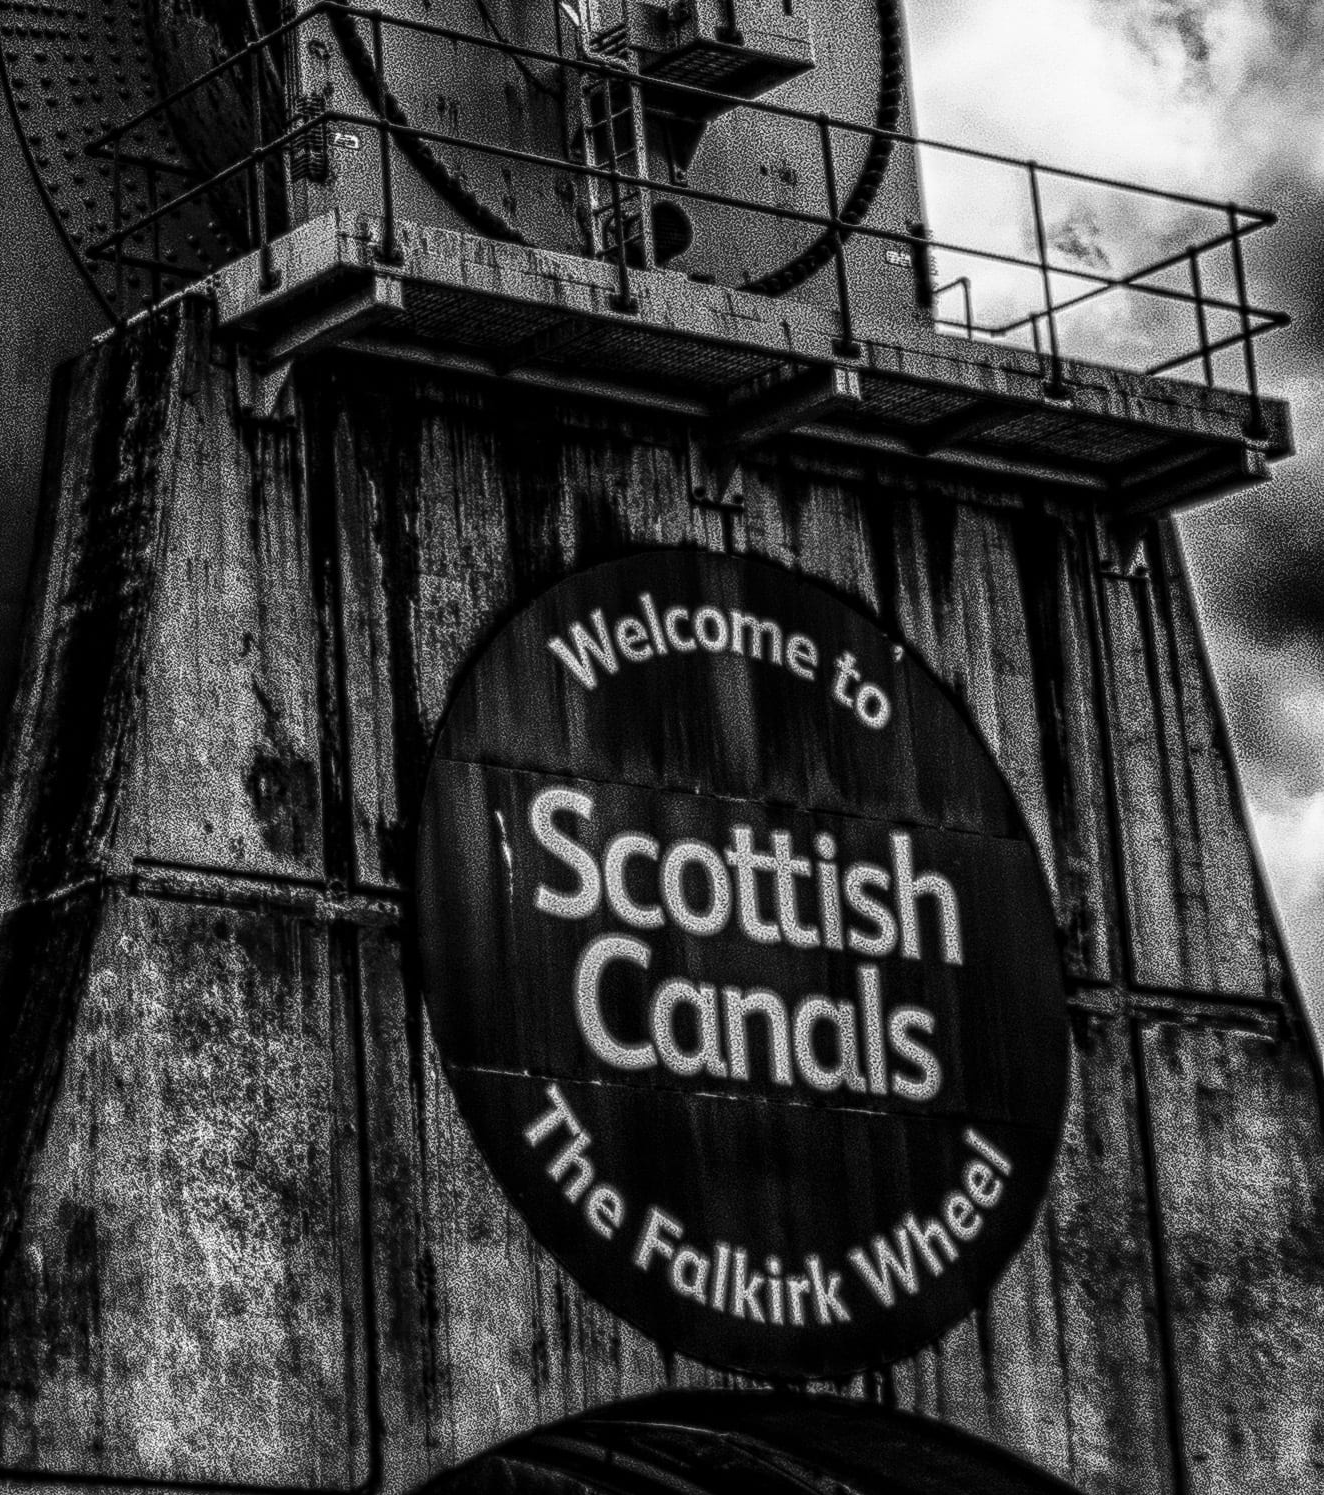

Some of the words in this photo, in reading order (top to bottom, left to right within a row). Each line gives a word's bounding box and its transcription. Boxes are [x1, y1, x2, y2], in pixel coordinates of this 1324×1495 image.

[547, 593, 818, 690] Welcome
[832, 651, 892, 730] to
[528, 785, 963, 965] Scottish
[574, 932, 942, 1100] Canals
[524, 1084, 626, 1239] The
[634, 1207, 851, 1326] Falkirk
[850, 1128, 1013, 1307] Wheel
